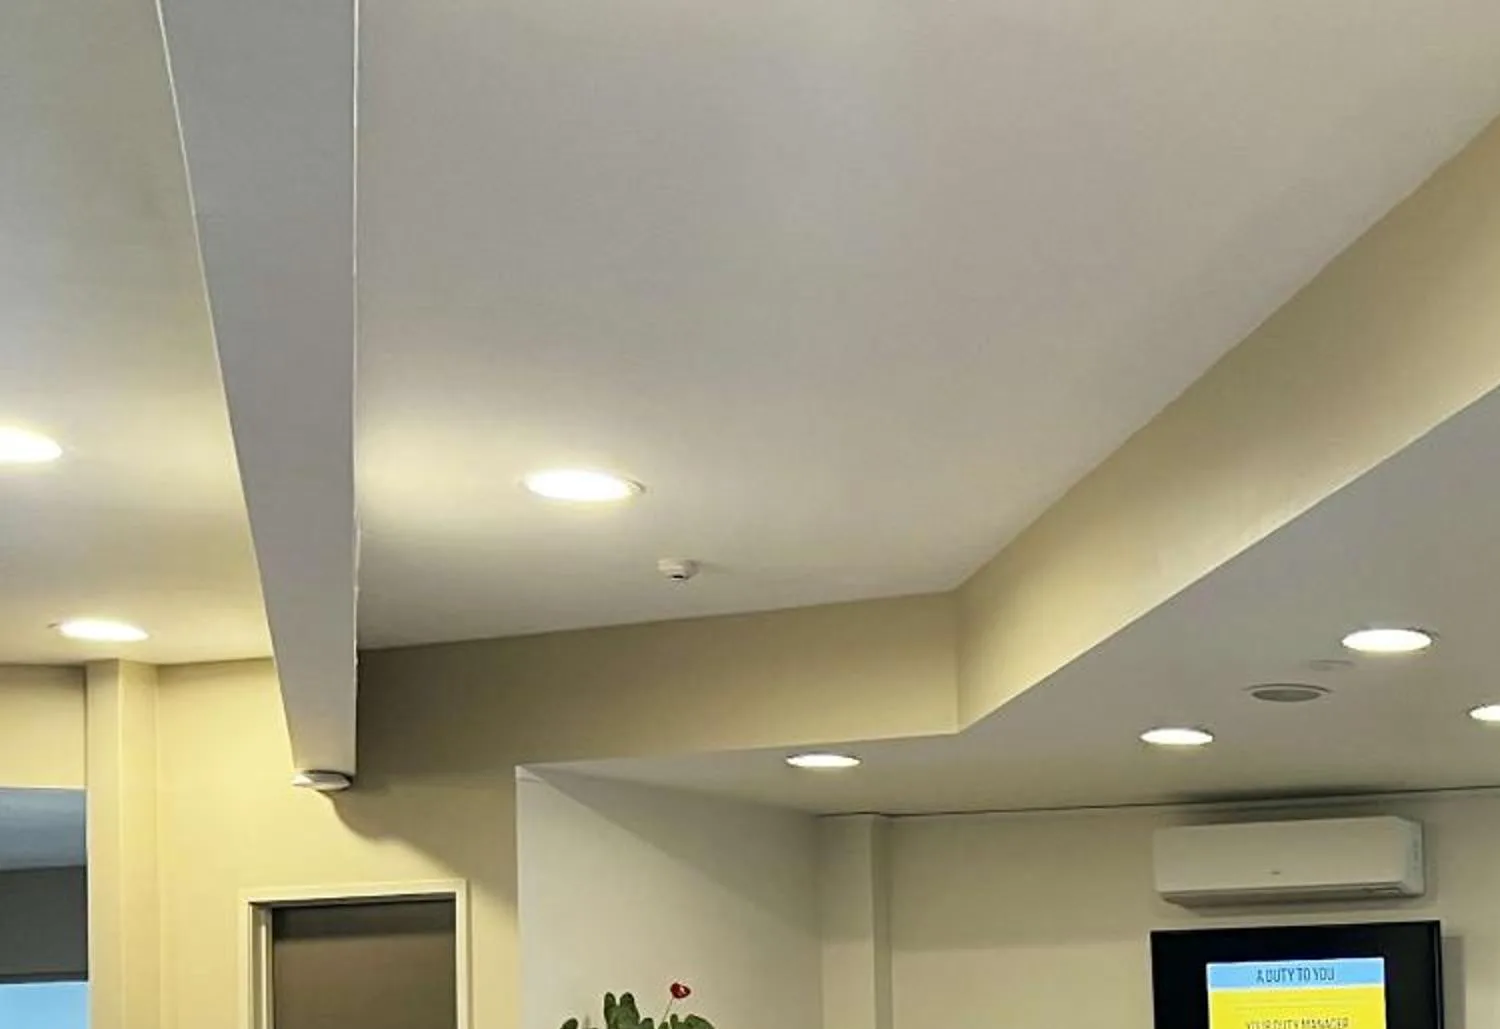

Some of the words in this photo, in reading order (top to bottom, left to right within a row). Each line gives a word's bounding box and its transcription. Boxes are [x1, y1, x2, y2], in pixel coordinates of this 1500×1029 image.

[1257, 968, 1265, 984] A
[1266, 967, 1295, 983] DUTY
[1296, 967, 1311, 981] TO
[1312, 966, 1335, 981] YOU
